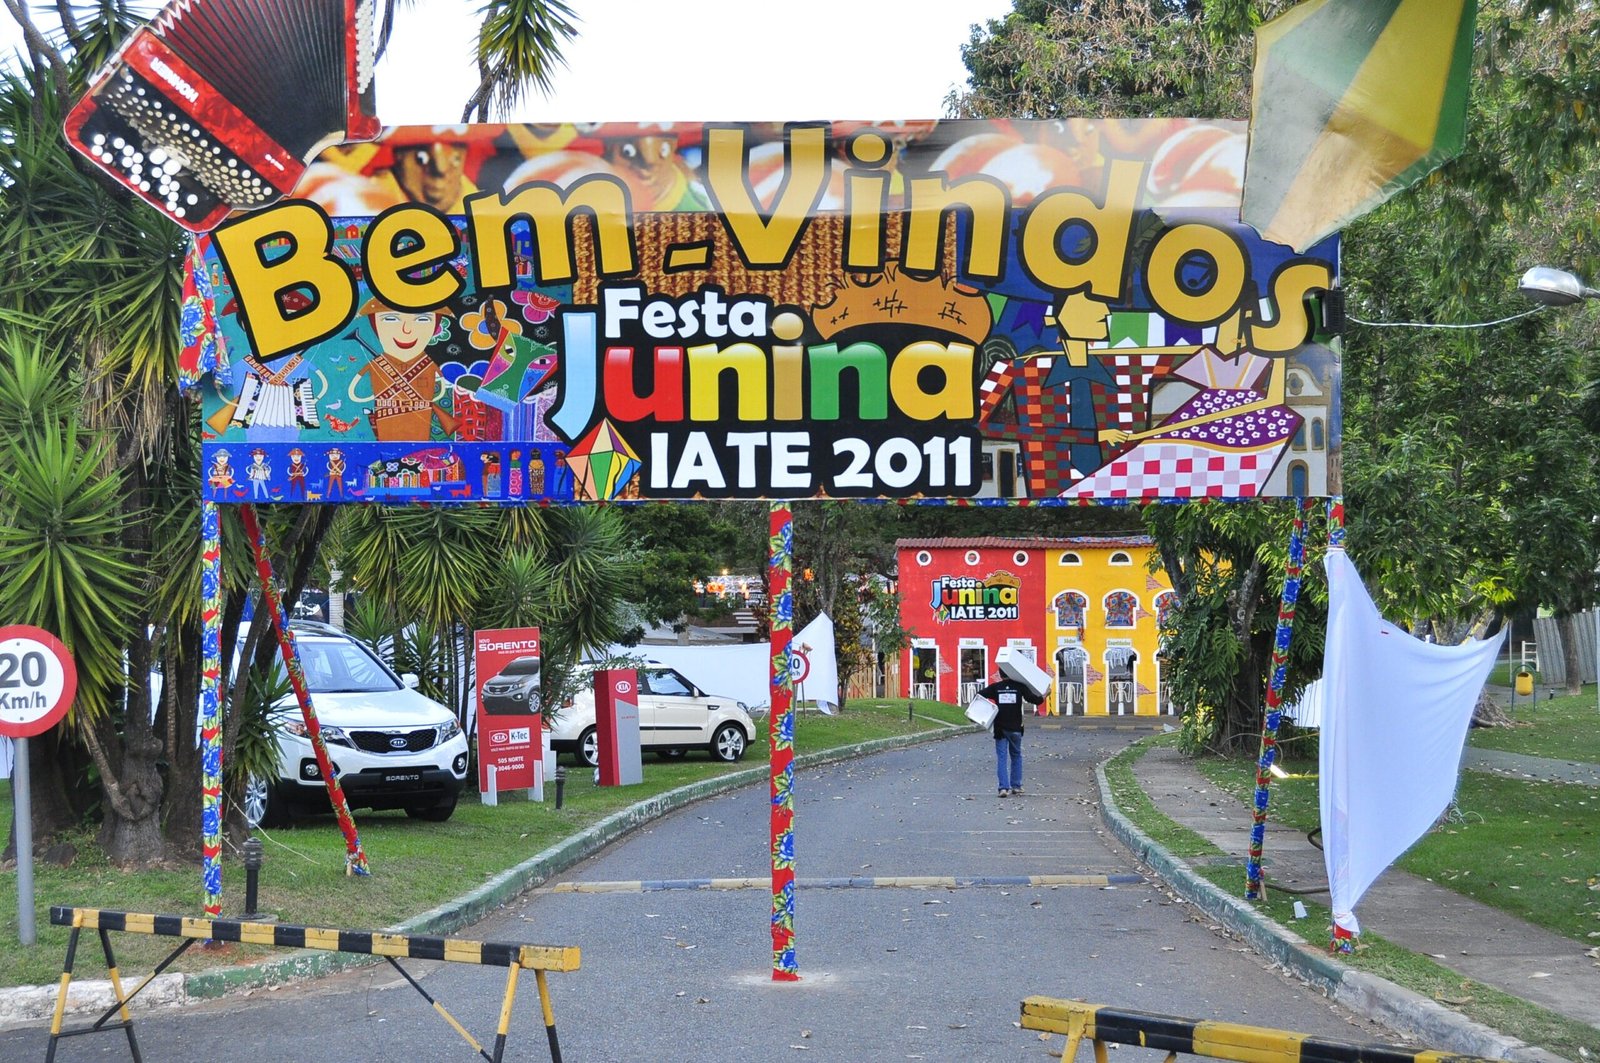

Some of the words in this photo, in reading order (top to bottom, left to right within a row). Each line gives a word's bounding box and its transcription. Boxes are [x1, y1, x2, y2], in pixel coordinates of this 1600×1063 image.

[603, 287, 768, 339] Festa
[551, 311, 975, 441] Junina
[650, 431, 812, 489] IATE
[832, 435, 972, 488] 2011
[941, 577, 976, 589] Festa
[931, 581, 1017, 609] Junina
[951, 606, 985, 619] IATE
[987, 606, 1017, 619] 2011
[478, 640, 537, 652] SORENTO
[0, 651, 47, 689] 20
[617, 682, 630, 692] KIA
[511, 731, 528, 740] K-Tec
[385, 774, 420, 782] SORENTO
